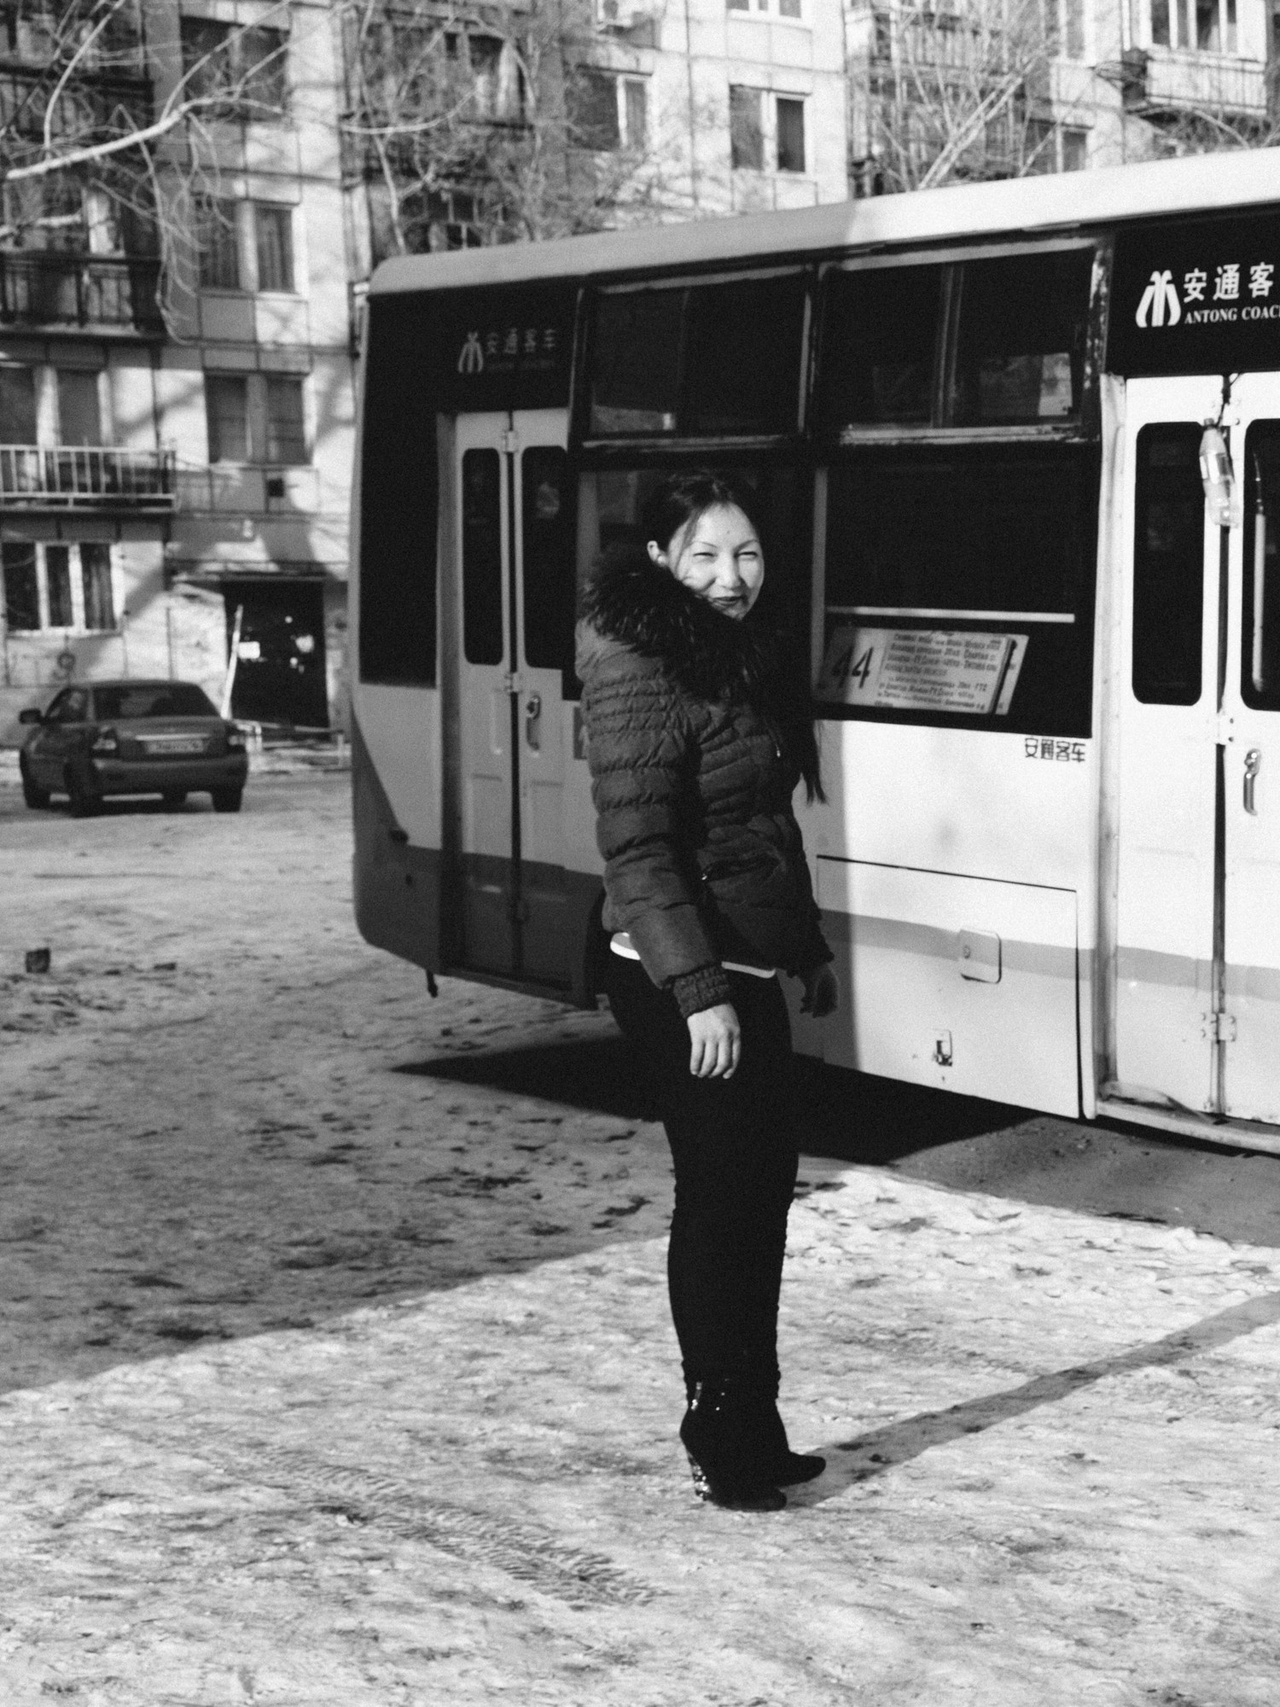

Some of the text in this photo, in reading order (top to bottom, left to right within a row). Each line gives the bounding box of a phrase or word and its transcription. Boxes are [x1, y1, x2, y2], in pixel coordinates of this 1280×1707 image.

[1183, 307, 1238, 325] ANTONG
[1024, 736, 1086, 763] 安通客车
